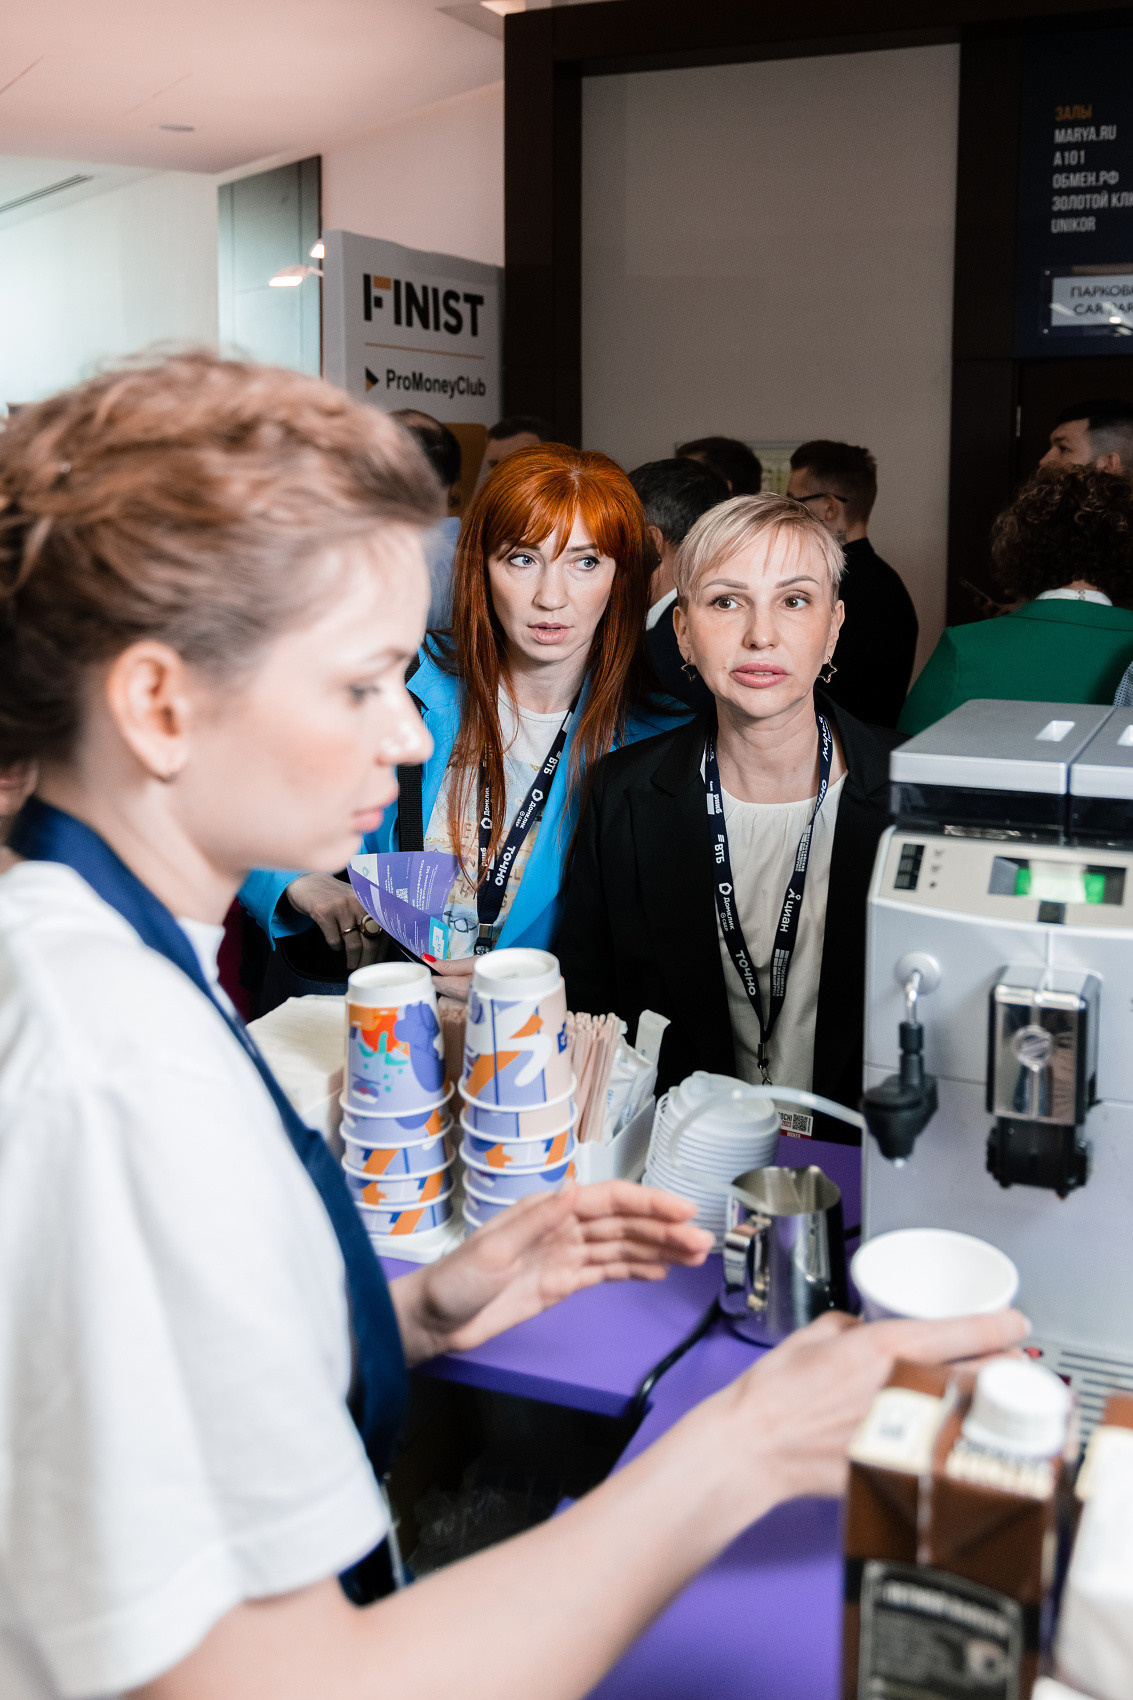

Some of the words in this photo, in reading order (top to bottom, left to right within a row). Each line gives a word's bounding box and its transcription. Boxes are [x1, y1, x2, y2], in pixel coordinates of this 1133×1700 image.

[1056, 105, 1092, 121] ЗАЛЫ
[1054, 124, 1117, 143] MARYA.RU
[1053, 170, 1119, 189] ОБМЕН.РФ
[1052, 190, 1109, 211] ЗОЛОТОЙ
[1051, 216, 1096, 233] UNIKOR
[1070, 284, 1133, 298] ПАРКОВ
[363, 273, 484, 337] FINIST
[1073, 302, 1104, 316] CAR
[386, 369, 486, 399] ProMoneyClub
[543, 756, 559, 775] ВТБ
[714, 843, 725, 864] ВТБ
[494, 845, 516, 886] ТОЧНО
[735, 949, 756, 996] ТОЧНО
